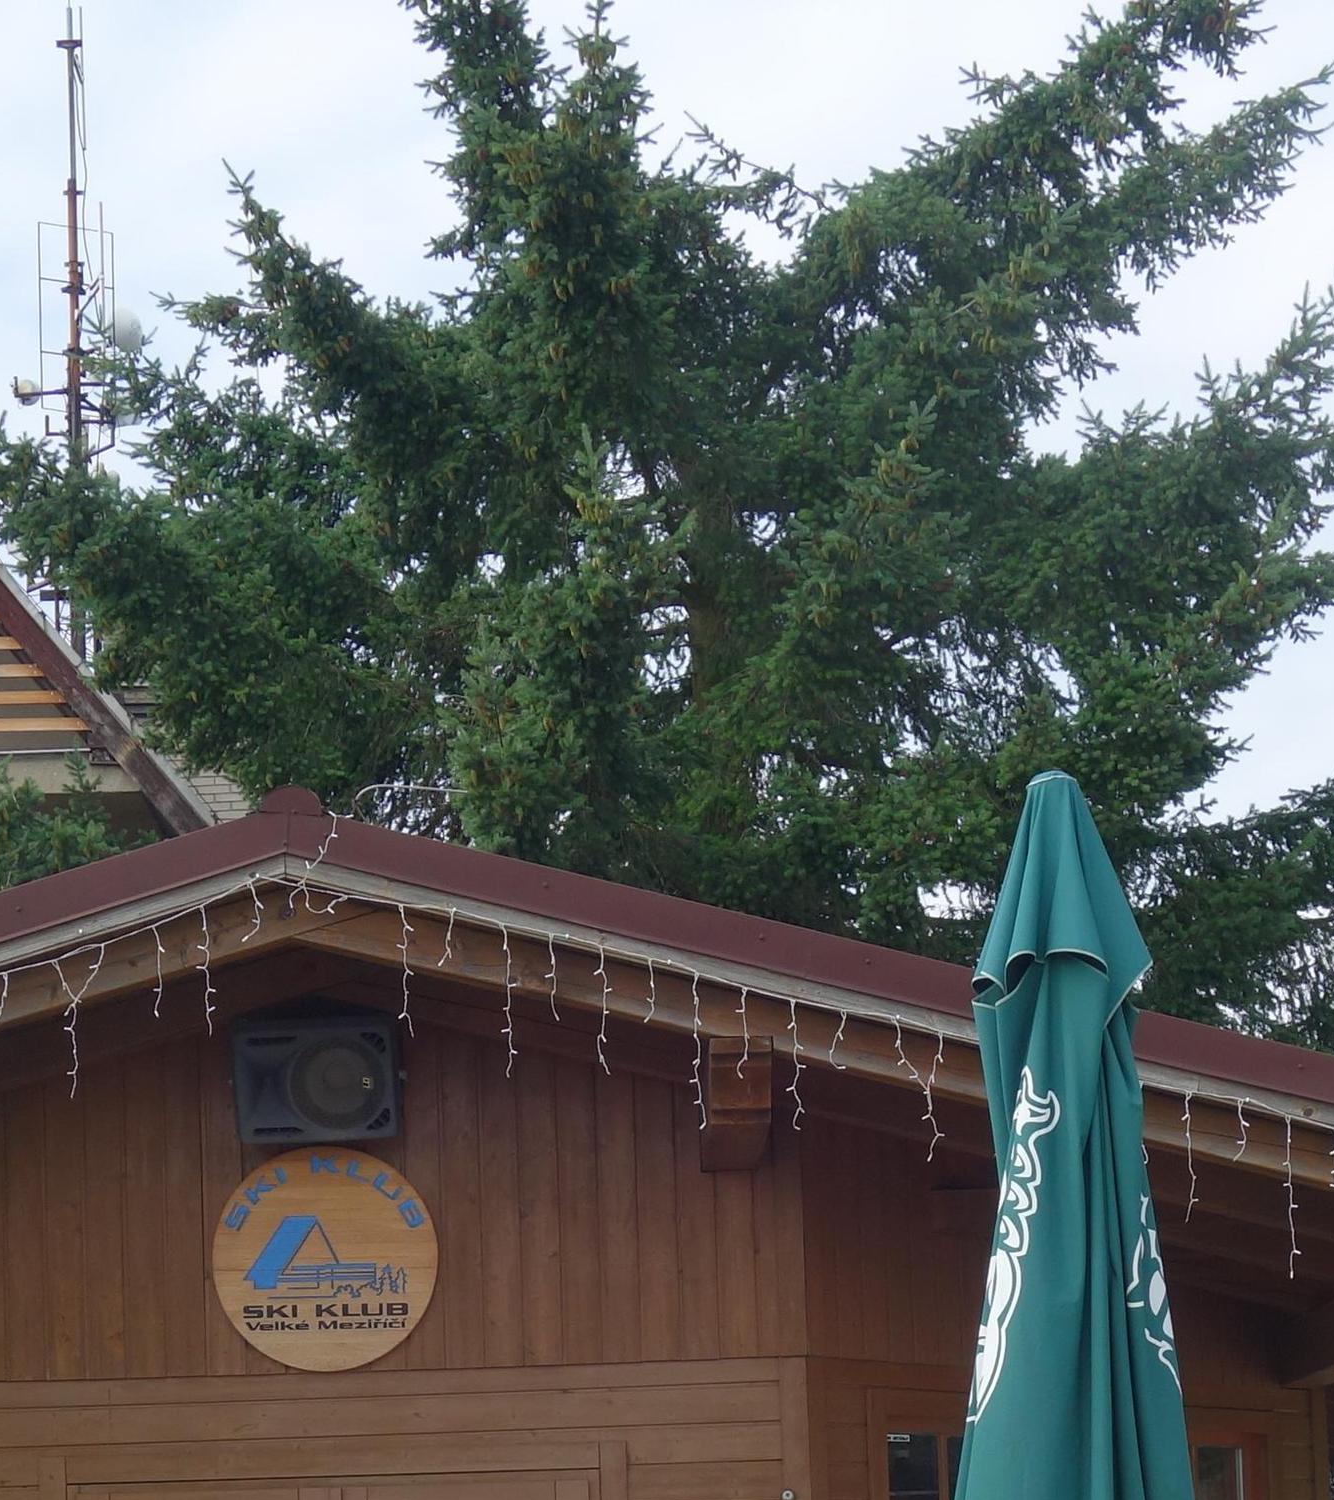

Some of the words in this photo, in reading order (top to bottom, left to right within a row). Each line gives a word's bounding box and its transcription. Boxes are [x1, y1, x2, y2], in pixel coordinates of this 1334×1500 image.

[224, 1166, 288, 1232] SKI
[309, 1153, 425, 1229] KLUB
[242, 1303, 298, 1319] SKI
[315, 1302, 409, 1318] KLUB
[245, 1318, 310, 1332] Velké
[317, 1317, 407, 1331] Meziříčí
